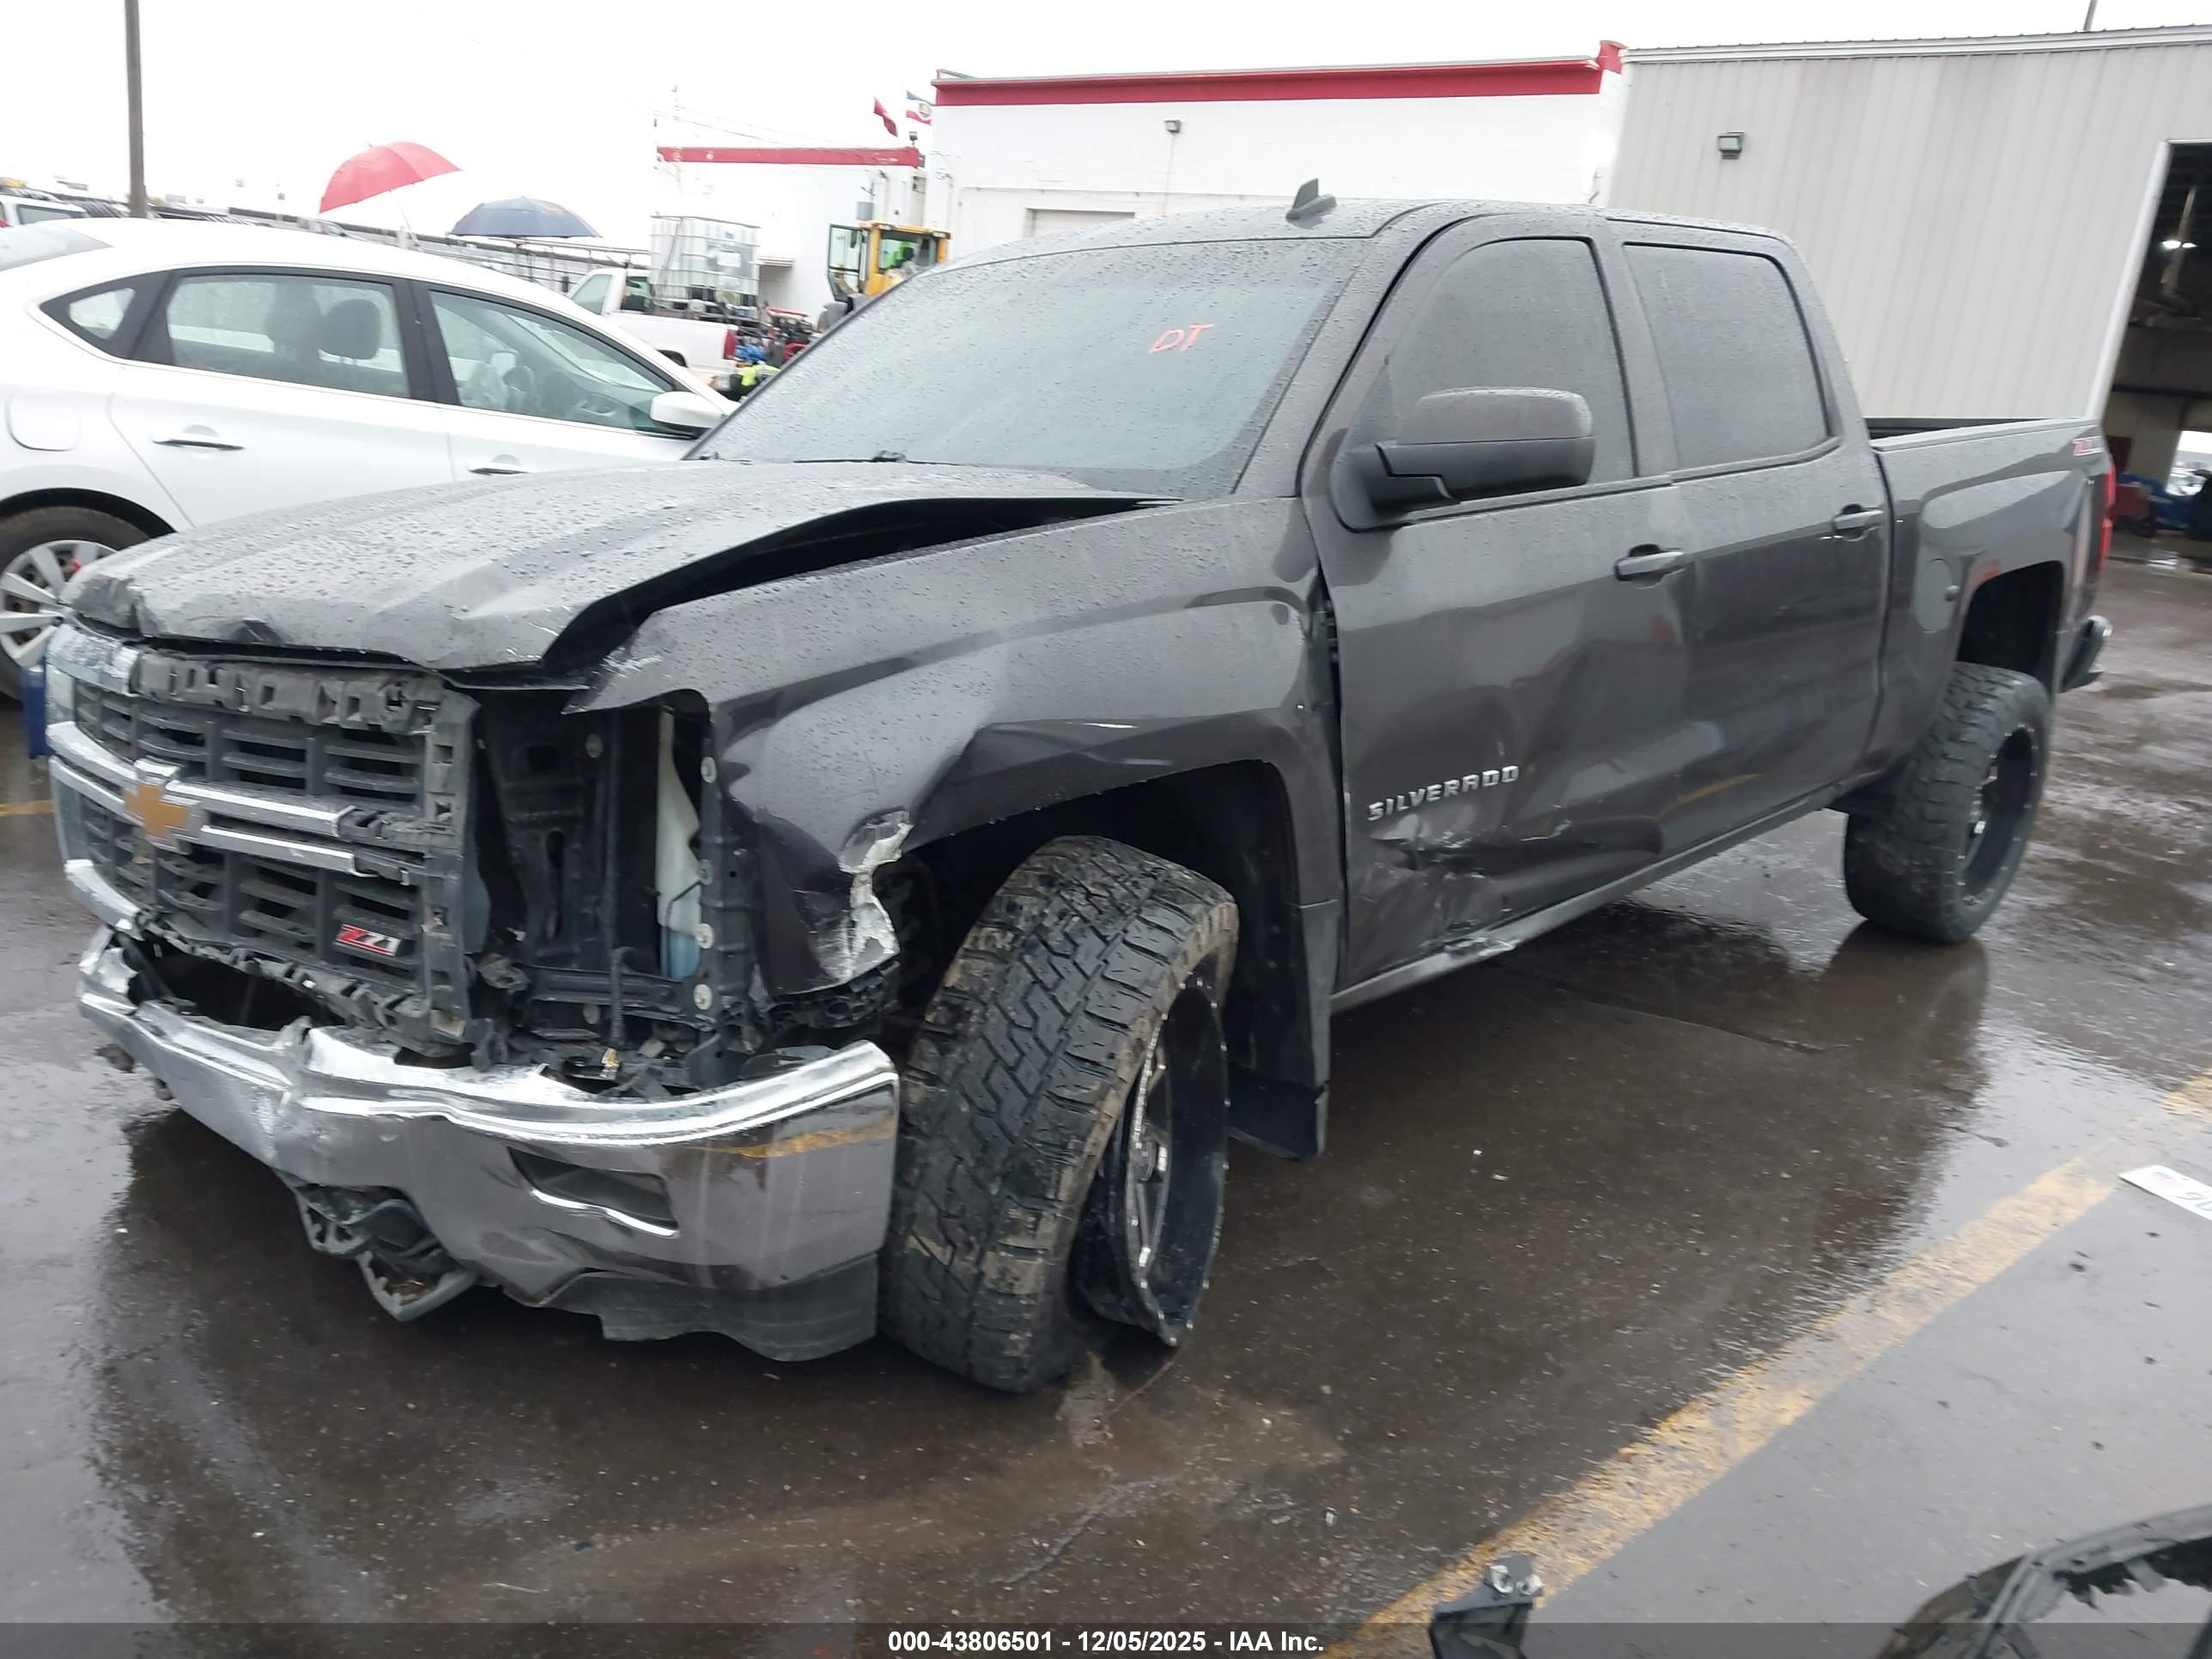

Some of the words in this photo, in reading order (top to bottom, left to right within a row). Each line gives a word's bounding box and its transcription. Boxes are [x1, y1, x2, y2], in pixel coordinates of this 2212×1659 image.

[1147, 323, 1215, 355] DT
[1367, 765, 1519, 821] SILVERADO
[336, 923, 402, 957] Z71
